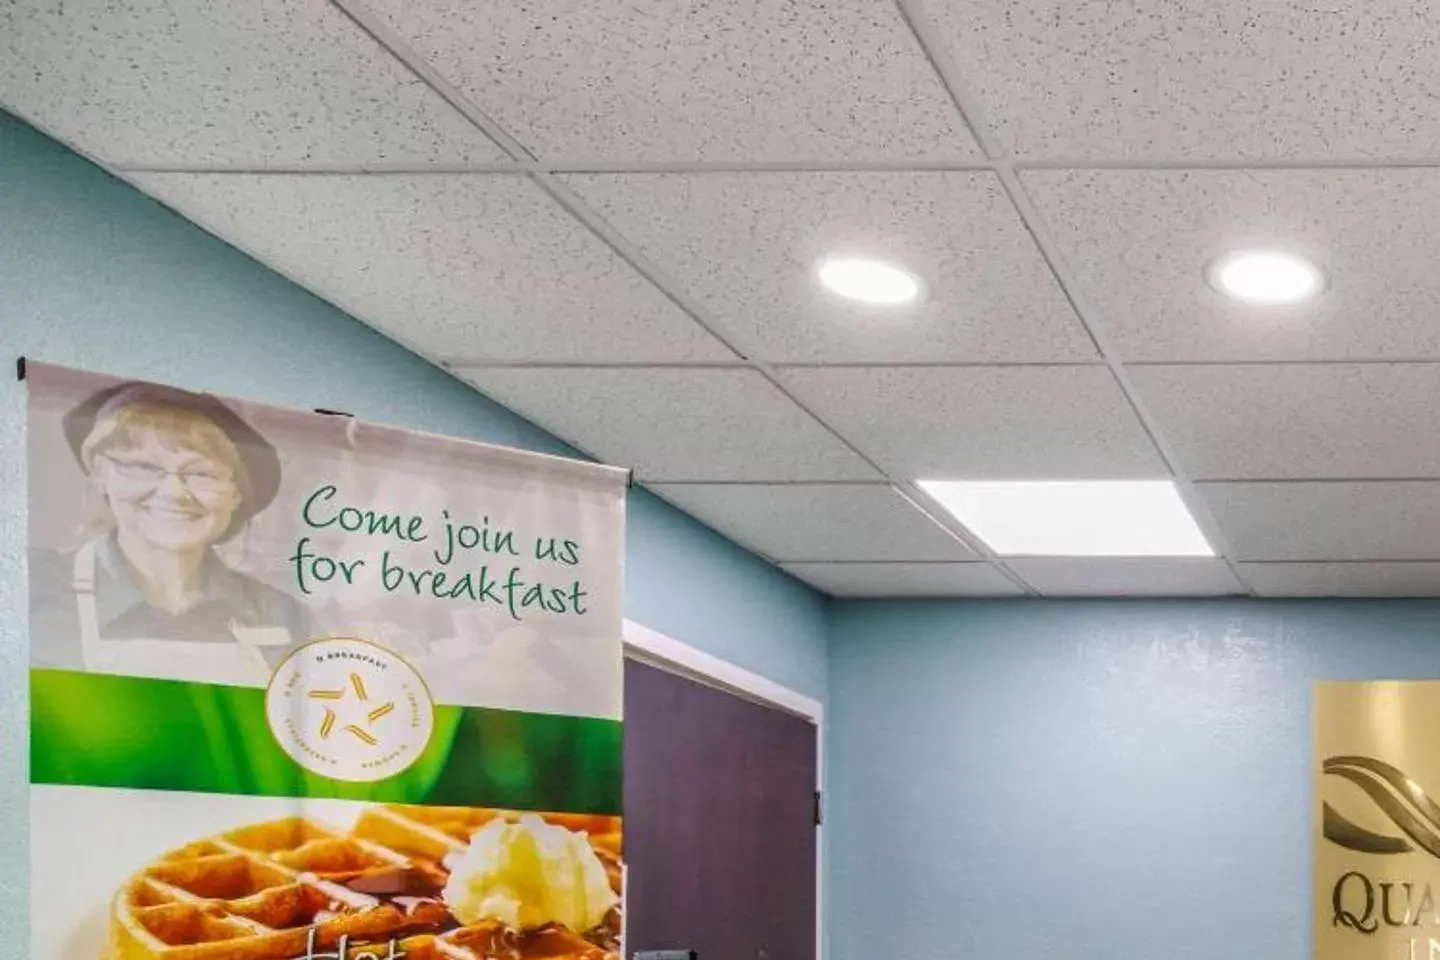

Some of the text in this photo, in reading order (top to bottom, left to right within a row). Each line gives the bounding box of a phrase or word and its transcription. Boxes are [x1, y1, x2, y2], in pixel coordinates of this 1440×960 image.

[302, 485, 580, 566] Come join us
[289, 537, 588, 621] for breakfast
